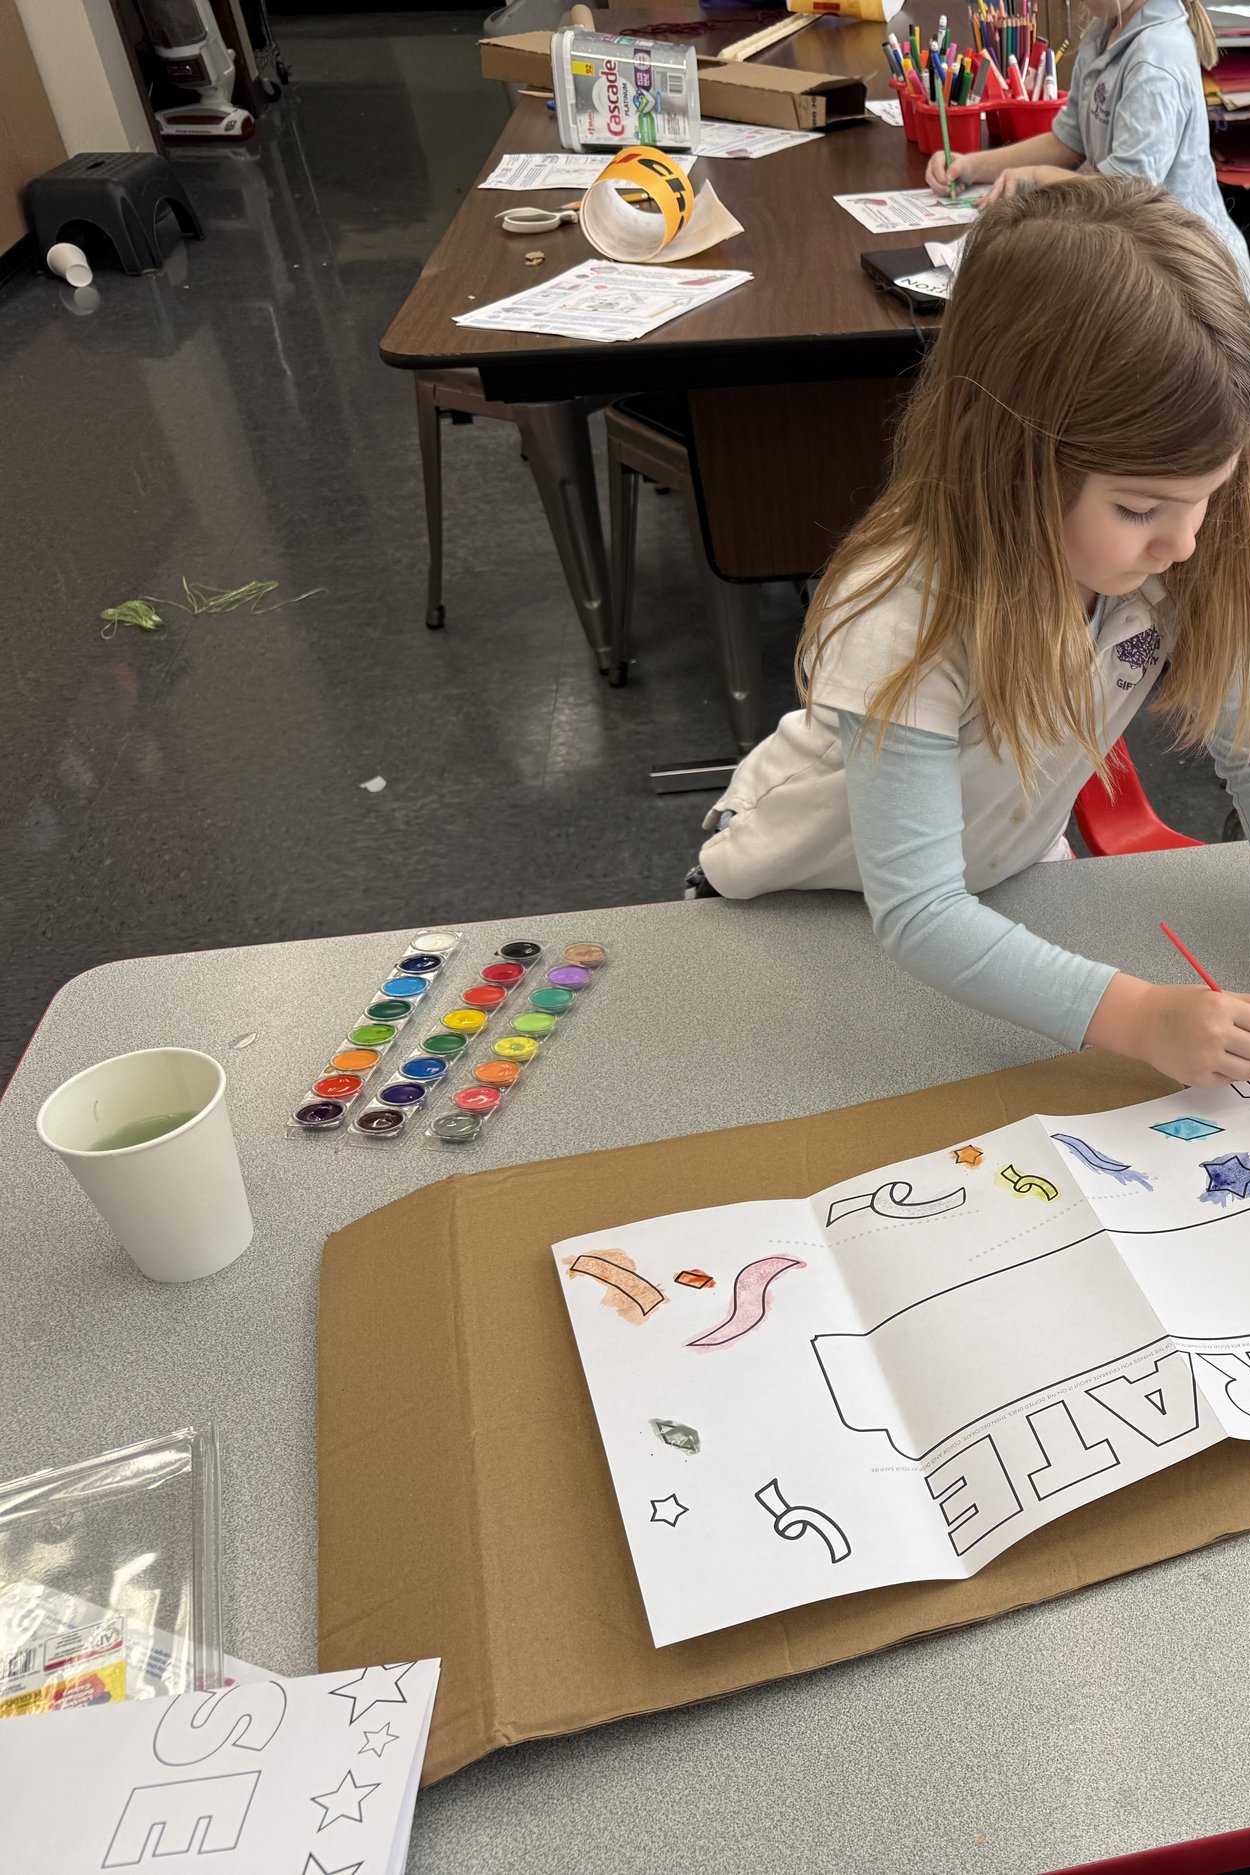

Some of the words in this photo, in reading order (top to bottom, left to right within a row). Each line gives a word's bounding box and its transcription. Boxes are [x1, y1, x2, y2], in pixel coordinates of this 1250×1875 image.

[601, 59, 625, 137] Cascade
[620, 83, 629, 117] PLATINUM
[1133, 1352, 1154, 1364] THINGS
[1121, 1362, 1133, 1370] YOU
[1094, 1367, 1120, 1381] CELEBRATE
[1074, 1379, 1092, 1388] ABOUT
[1024, 1397, 1045, 1409] DOTTED
[991, 1415, 1006, 1424] THEN
[943, 1440, 961, 1454] COLOR
[931, 1452, 942, 1464] AND
[911, 1462, 930, 1472] DISPLAY
